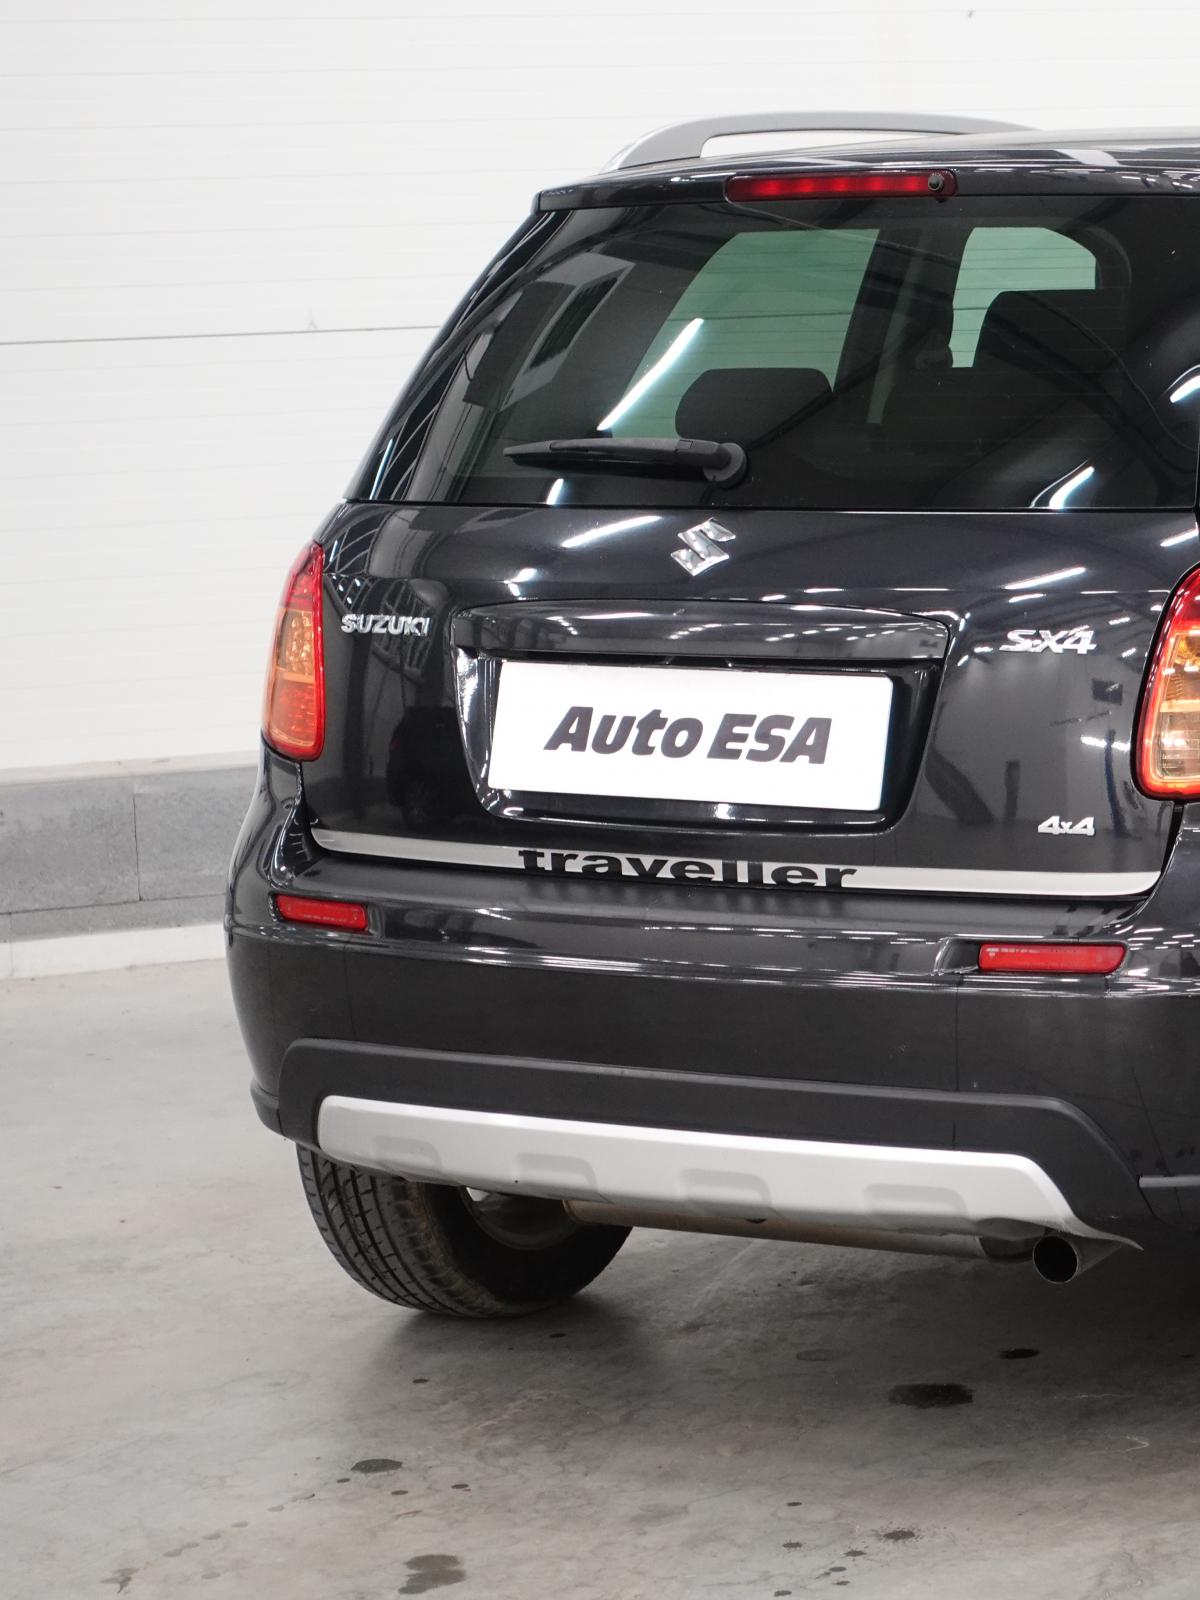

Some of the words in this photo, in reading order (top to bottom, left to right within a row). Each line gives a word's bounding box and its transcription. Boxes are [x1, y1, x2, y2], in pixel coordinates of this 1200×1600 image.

[341, 613, 431, 636] SUZUKI
[999, 625, 1096, 654] SX4
[543, 706, 704, 758] Auto
[706, 713, 832, 765] ESA
[1037, 815, 1095, 836] 4x4
[518, 849, 857, 889] traveller
